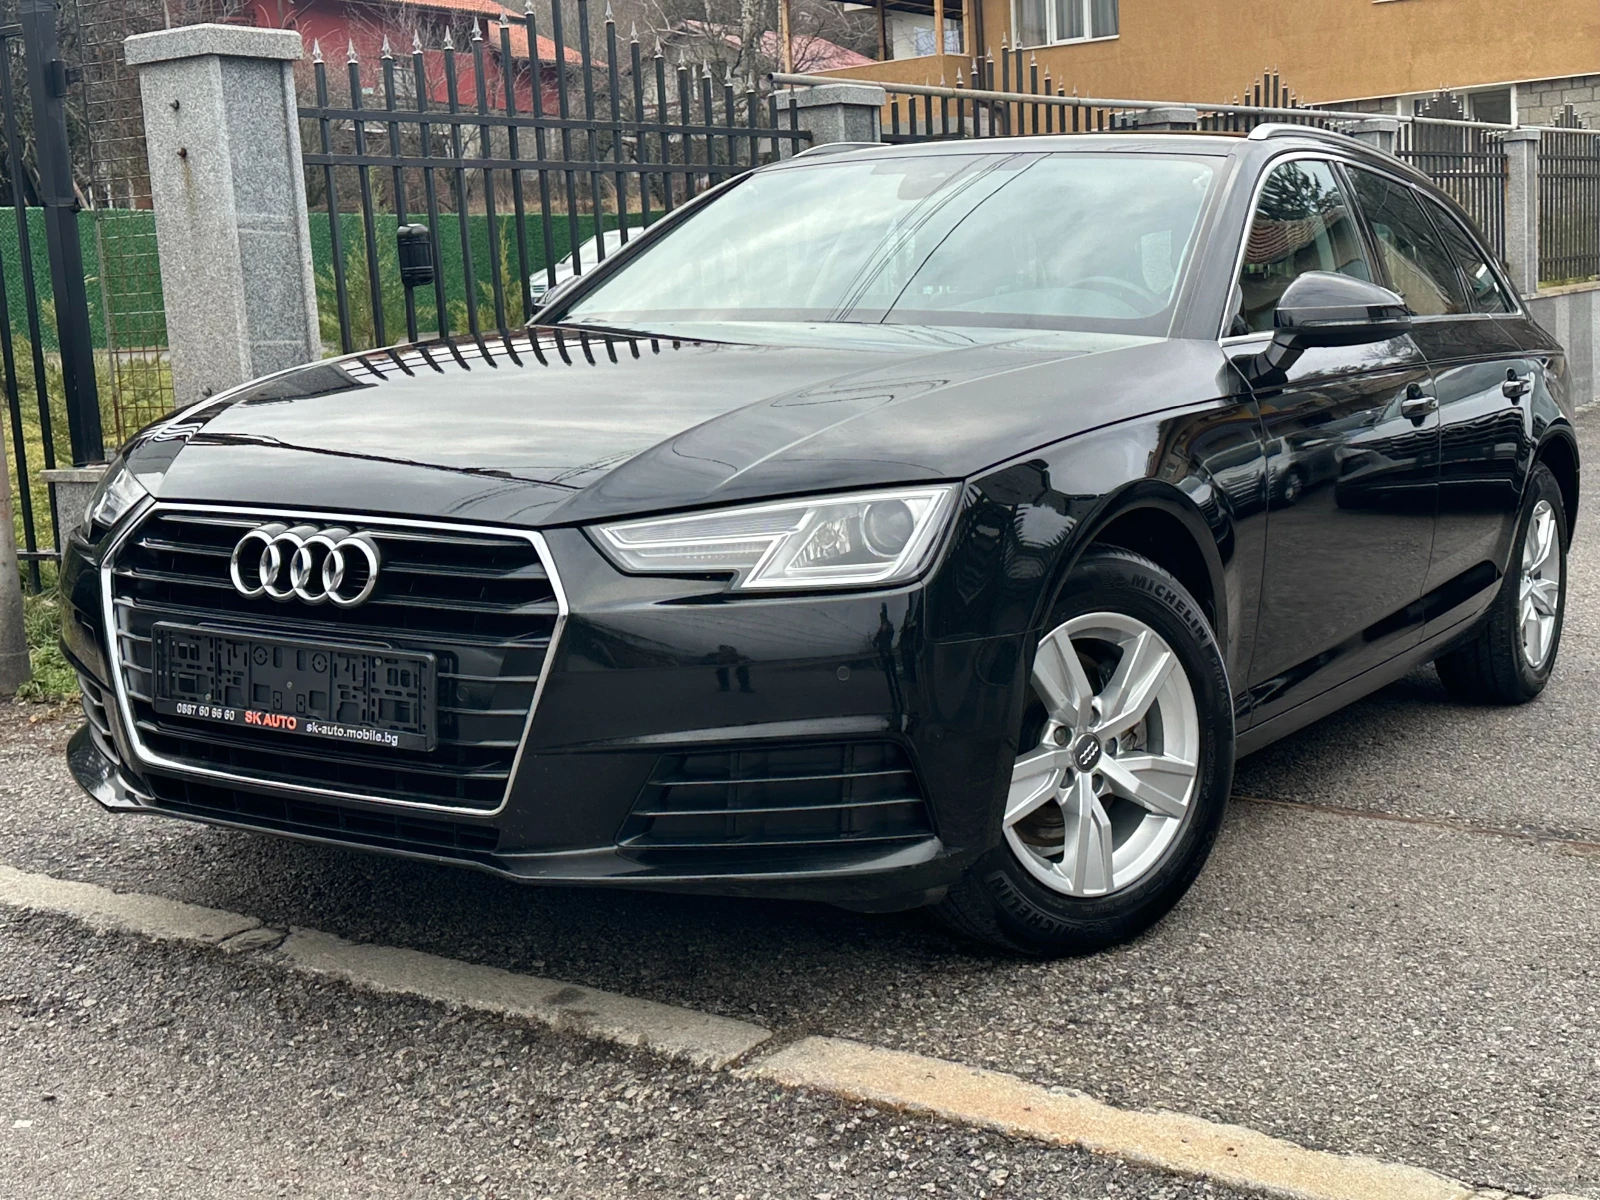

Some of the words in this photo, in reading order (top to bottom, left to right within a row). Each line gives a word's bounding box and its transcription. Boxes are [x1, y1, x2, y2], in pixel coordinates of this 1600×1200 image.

[1131, 573, 1208, 642] MICHELIN
[176, 703, 197, 715] 0887
[198, 705, 210, 717] 60
[211, 707, 222, 719] 66
[223, 709, 235, 721] 60
[245, 710, 262, 725] SK
[263, 714, 297, 730] AUTO
[306, 721, 398, 746] sk-auto.mobile.bg
